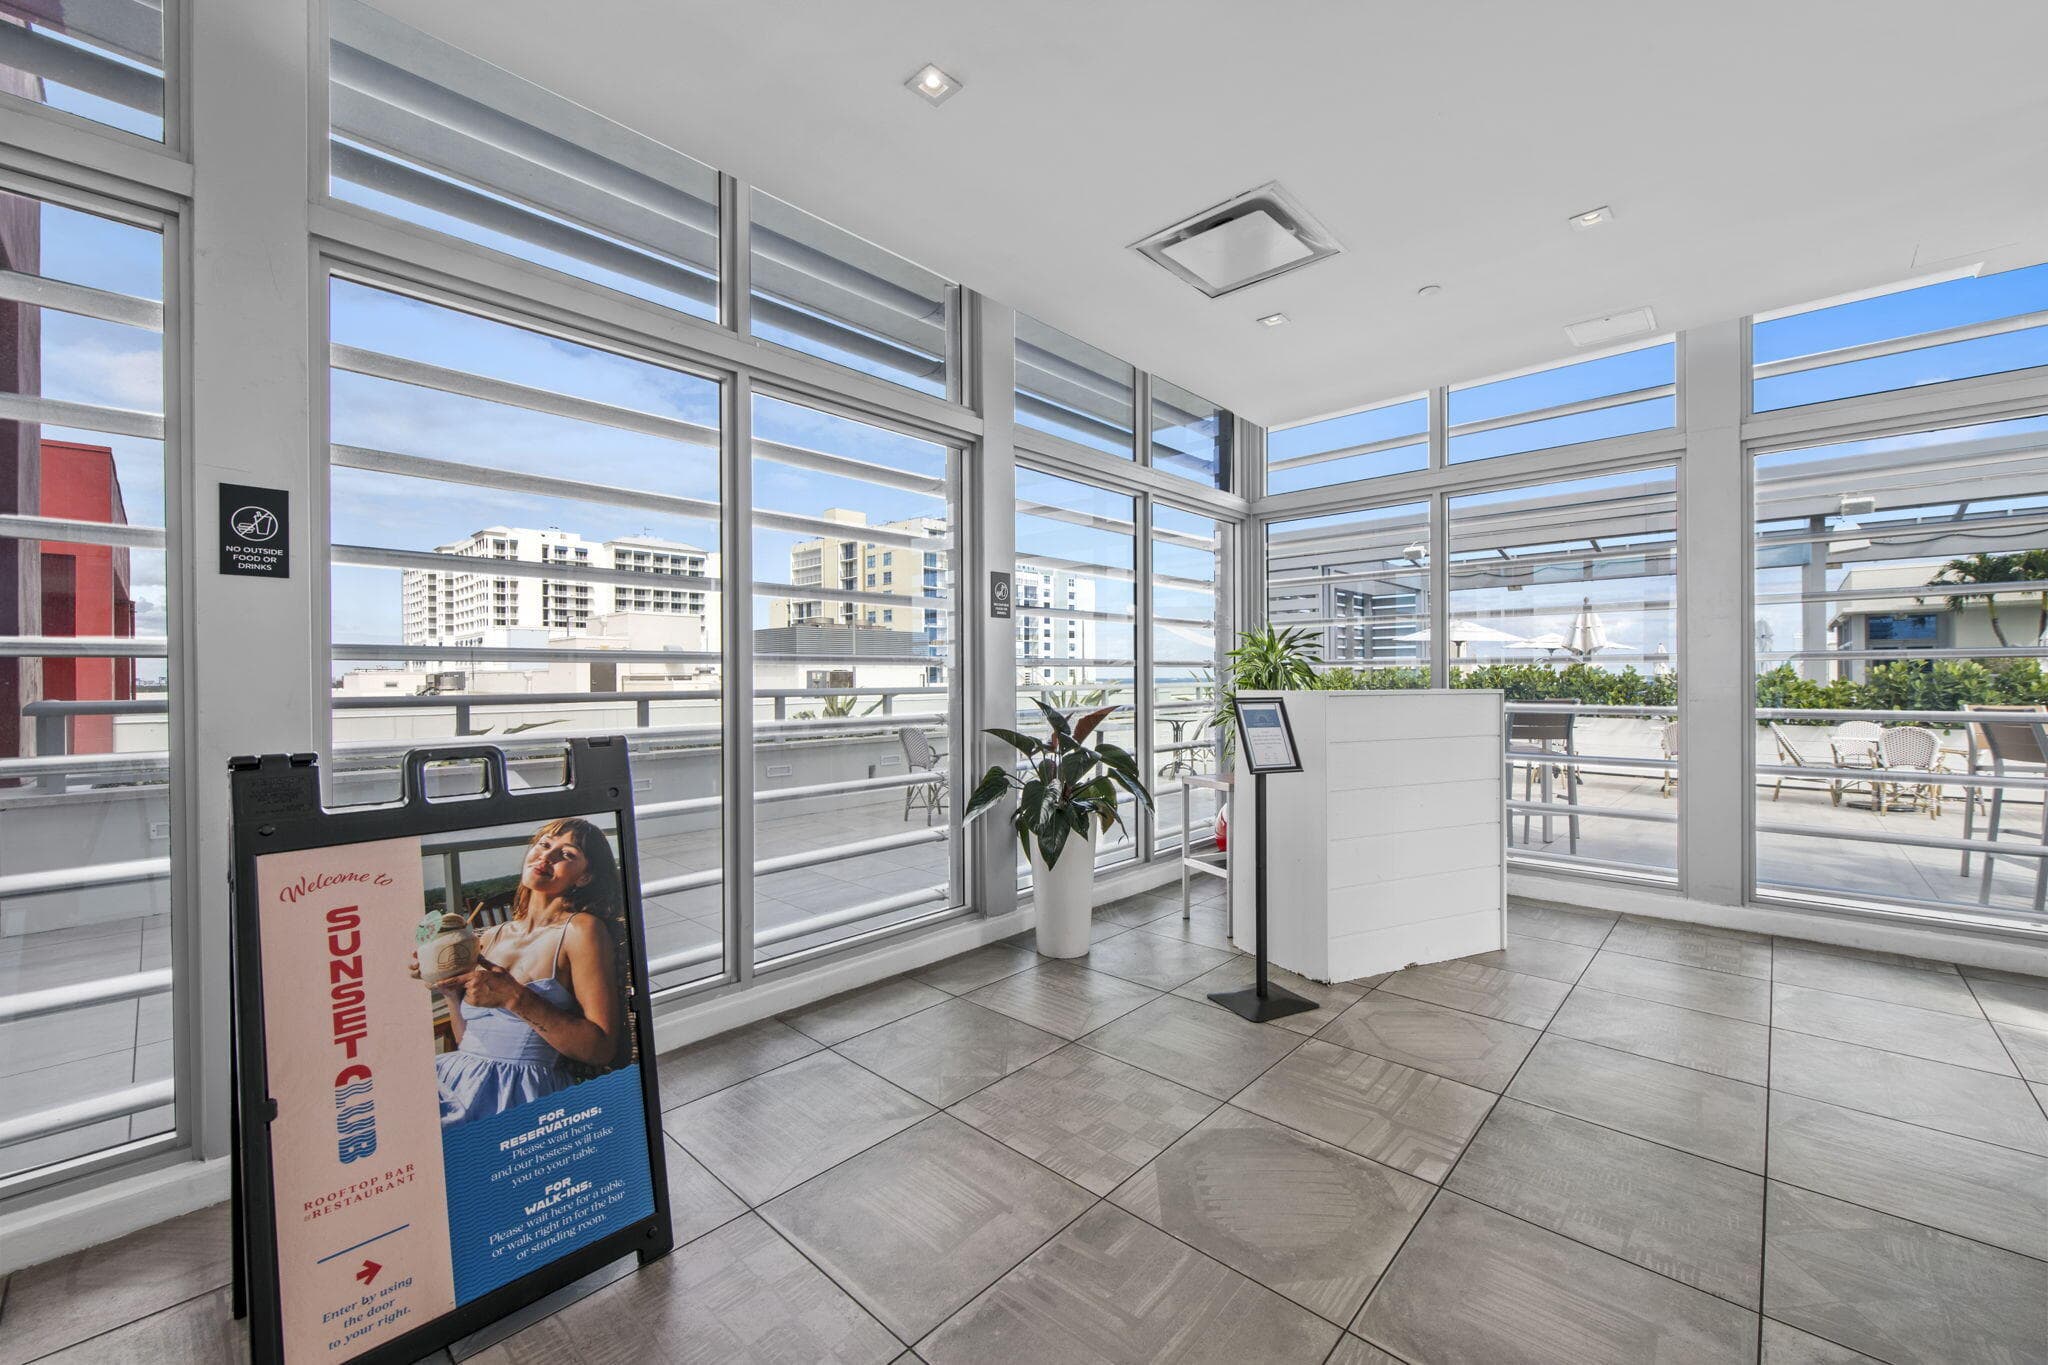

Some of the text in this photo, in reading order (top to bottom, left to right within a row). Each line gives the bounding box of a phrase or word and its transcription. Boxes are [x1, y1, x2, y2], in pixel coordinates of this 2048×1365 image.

[243, 547, 283, 555] OUTSIDE
[280, 873, 392, 902] Welcome to
[326, 905, 377, 1164] SUNSET CLUB
[500, 1106, 602, 1150] RESERVATIONS:
[539, 1109, 566, 1125] FOR
[491, 1126, 614, 1181] and our hostess will take
[512, 1122, 593, 1159] Please wait here
[304, 1164, 414, 1211] ROOFTOP BAR
[512, 1173, 531, 1188] you
[535, 1167, 544, 1177] to
[546, 1156, 570, 1173] your
[545, 1177, 572, 1196] FOR
[312, 1174, 415, 1218] RESTAURANT
[524, 1181, 592, 1215] WALK-INS:
[489, 1224, 524, 1245] Please
[527, 1211, 548, 1228] wait
[551, 1203, 573, 1217] here
[577, 1194, 591, 1206] for
[492, 1191, 625, 1258] or walk right in for the bar
[516, 1213, 606, 1260] or standing room.
[322, 1277, 413, 1323] Enter by using
[344, 1299, 395, 1328] the door
[329, 1306, 411, 1350] to your right.
